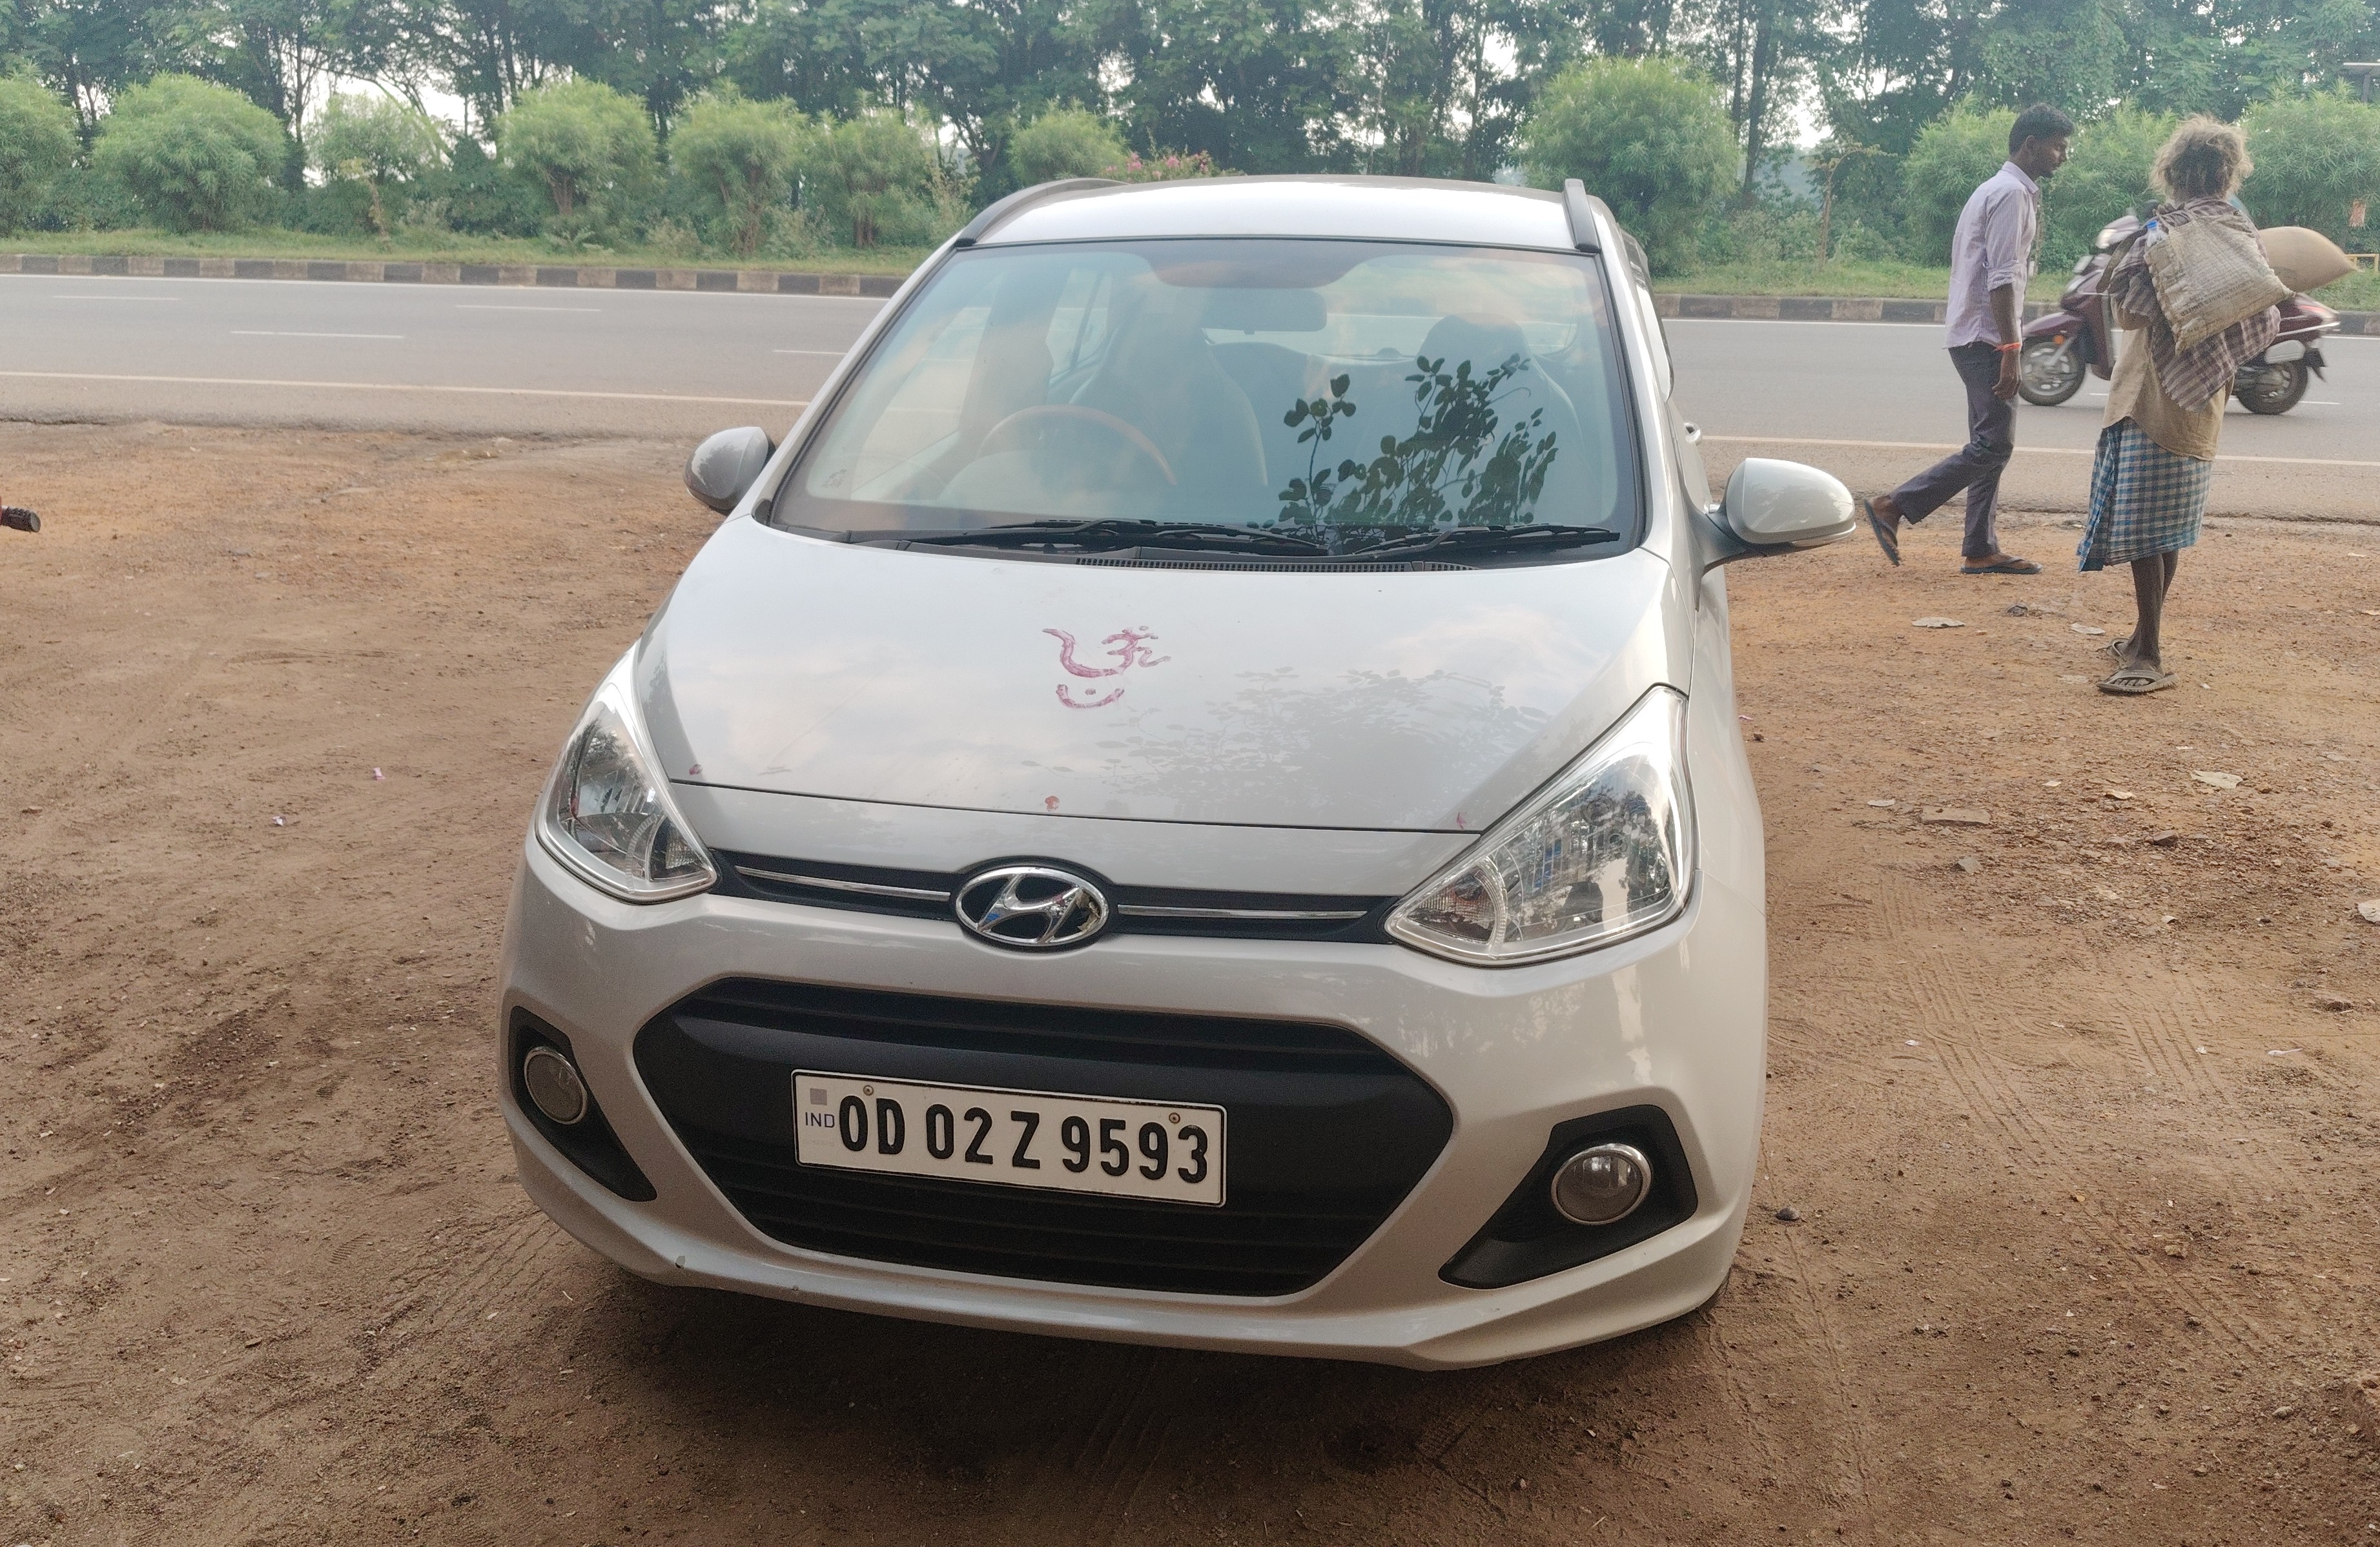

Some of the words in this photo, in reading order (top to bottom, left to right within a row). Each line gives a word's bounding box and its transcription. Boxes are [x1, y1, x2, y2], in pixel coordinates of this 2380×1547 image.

[805, 1111, 836, 1129] IND
[838, 1095, 906, 1156] OD
[925, 1103, 994, 1165] 02
[1010, 1110, 1041, 1170] Z
[1061, 1115, 1208, 1185] 9593
